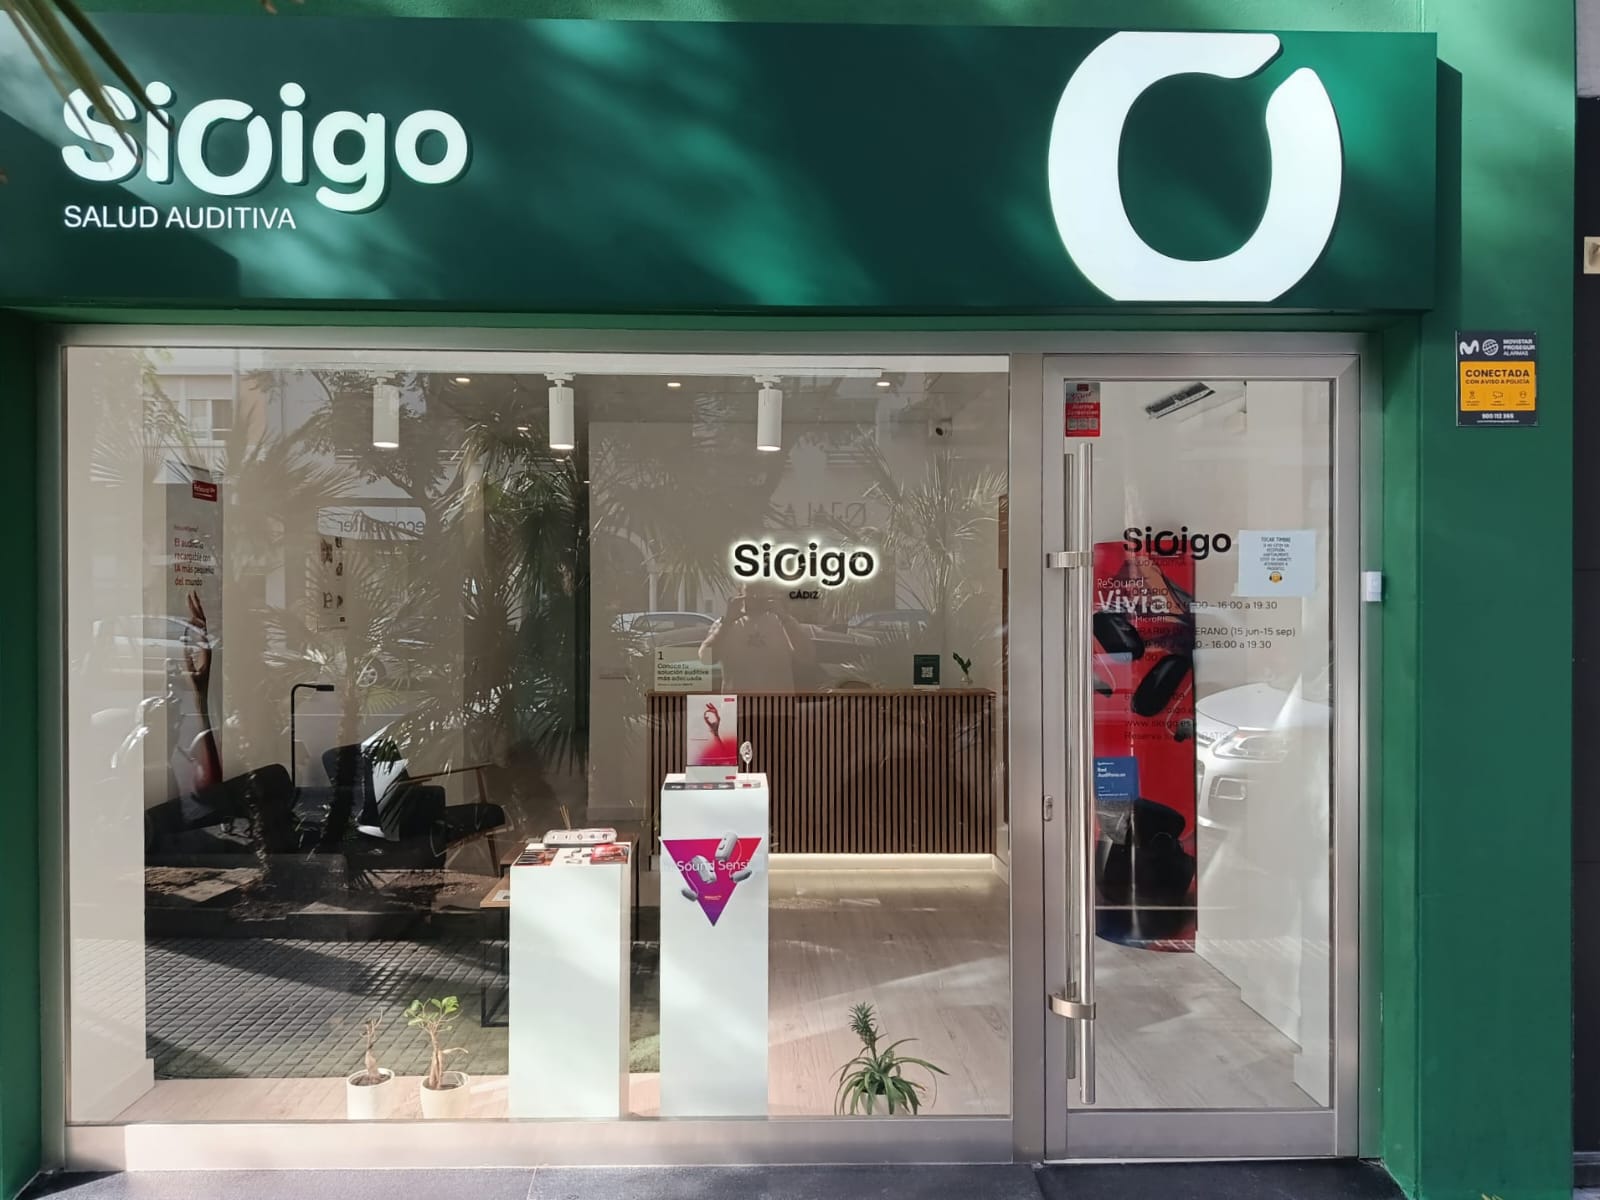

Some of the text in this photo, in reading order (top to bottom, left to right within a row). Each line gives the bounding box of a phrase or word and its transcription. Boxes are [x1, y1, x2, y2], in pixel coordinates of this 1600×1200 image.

[61, 81, 469, 213] SiOigo
[63, 205, 297, 230] SALUD AUDITIVA
[1465, 369, 1530, 378] CONECTADA
[1097, 576, 1144, 588] ReSound
[788, 589, 820, 600] CÁDIZ
[1098, 588, 1170, 614] Vivia
[1189, 626, 1229, 637] ERANO
[1275, 626, 1297, 638] sep)
[657, 650, 664, 660] 1
